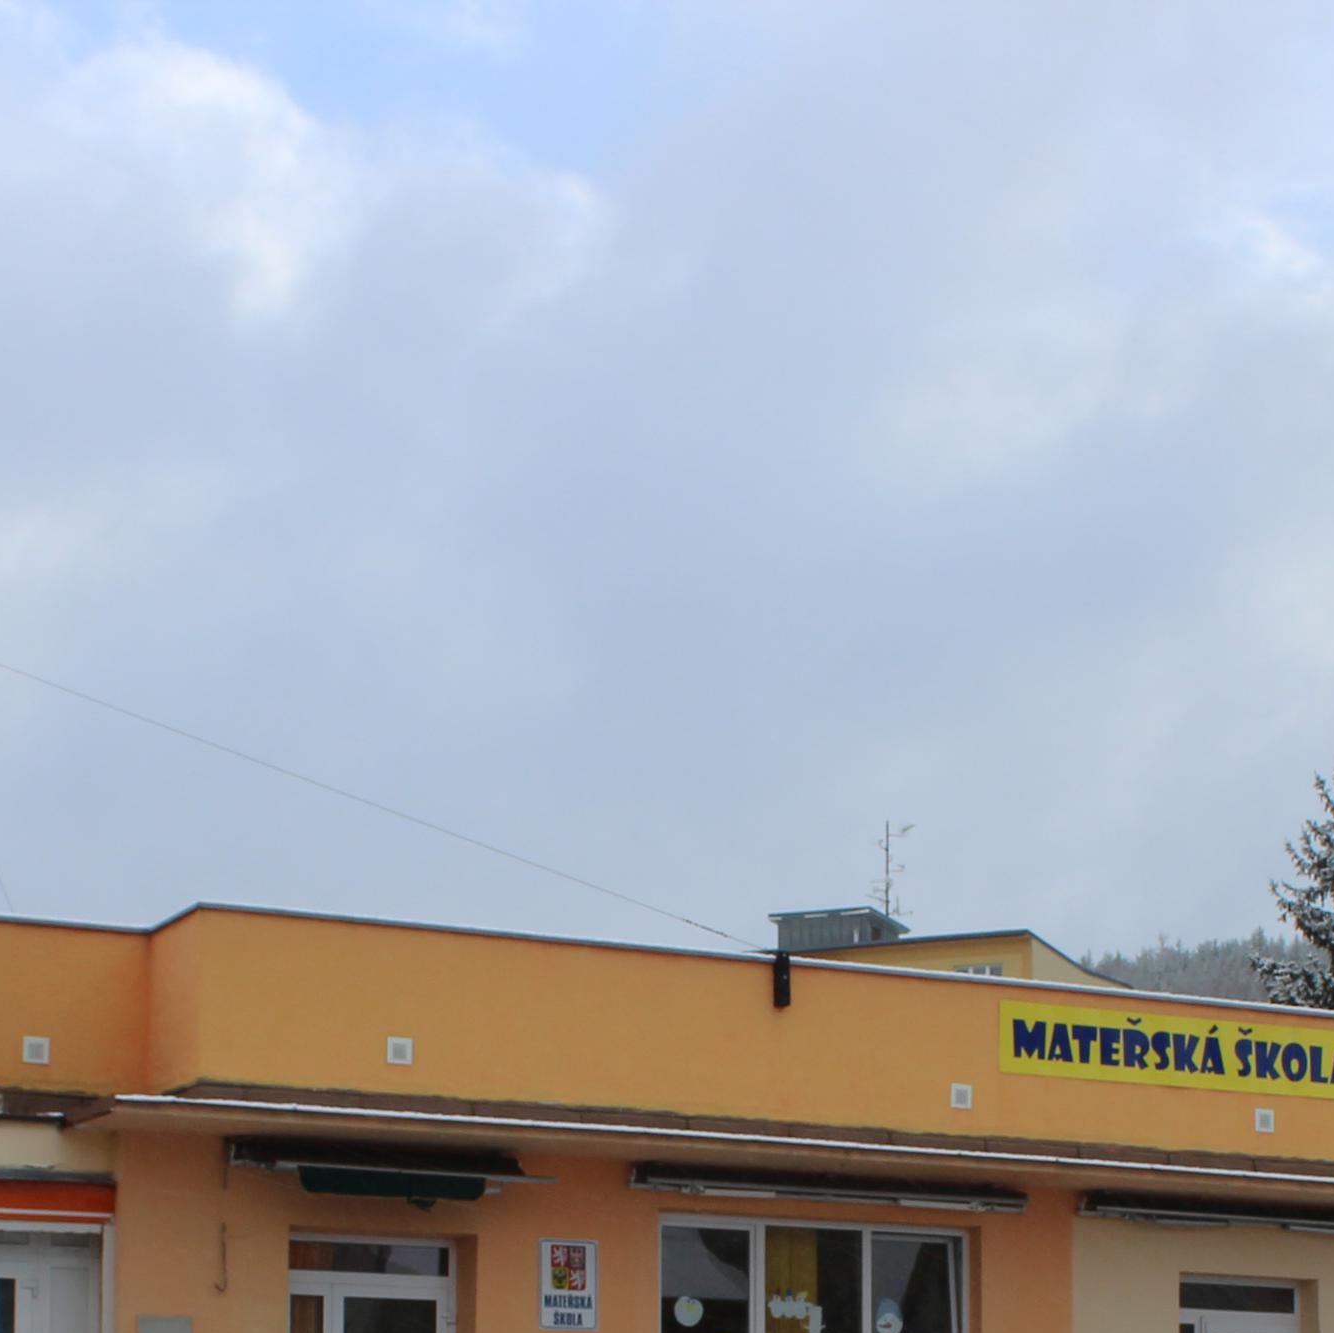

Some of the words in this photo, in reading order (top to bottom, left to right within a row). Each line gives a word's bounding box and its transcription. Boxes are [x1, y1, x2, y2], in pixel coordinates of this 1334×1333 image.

[1012, 1017, 1225, 1075] MATEŘSKÁ
[544, 1294, 593, 1310] MATEŘSKÁ
[553, 1311, 583, 1326] ŠKOLA
